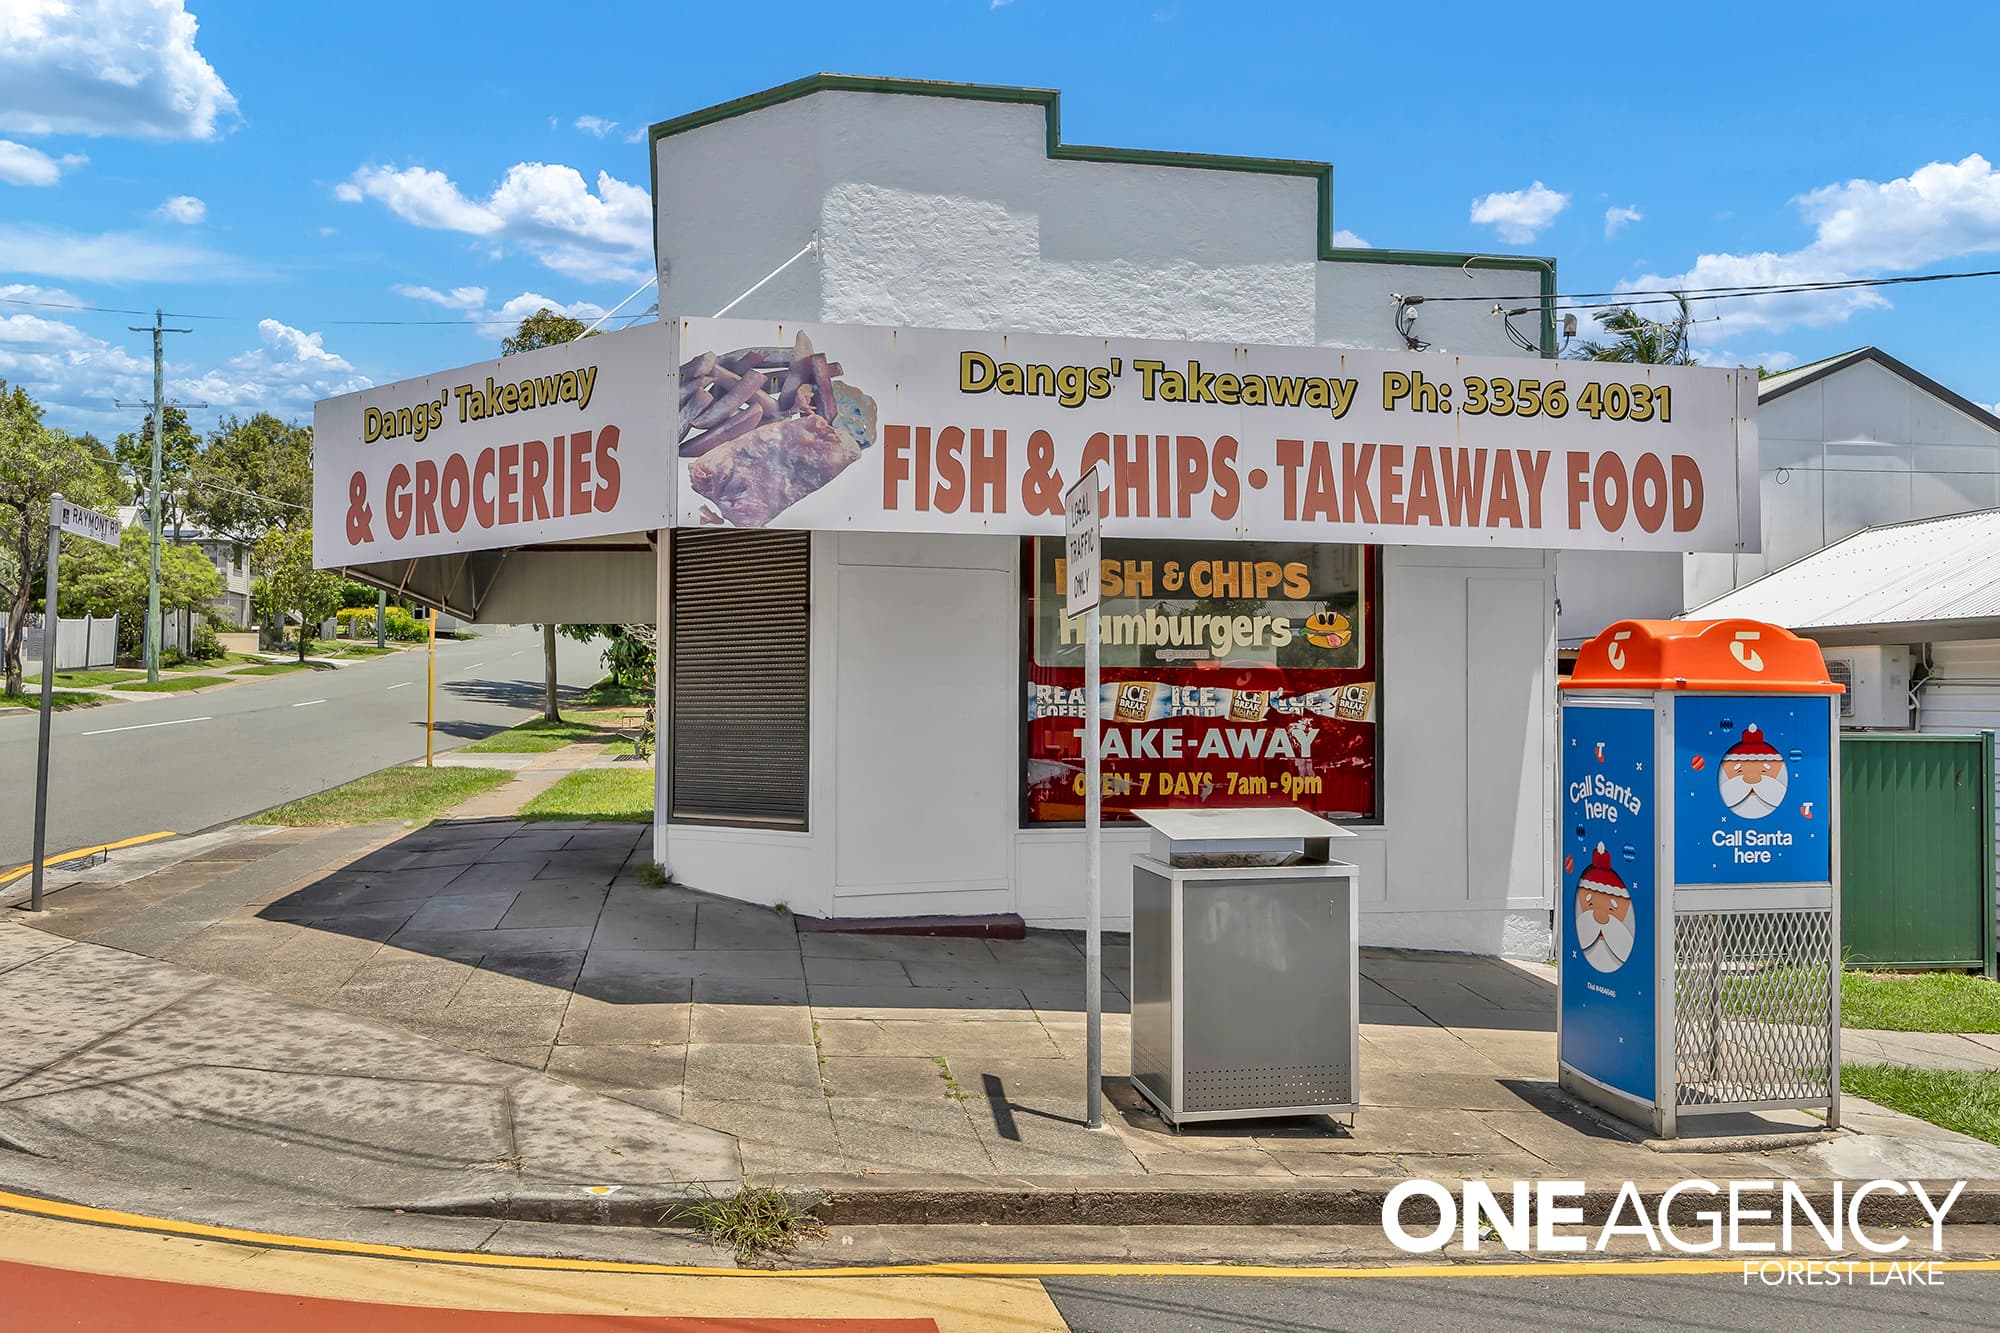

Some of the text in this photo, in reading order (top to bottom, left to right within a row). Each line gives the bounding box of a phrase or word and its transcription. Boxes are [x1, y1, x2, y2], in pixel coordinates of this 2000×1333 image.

[960, 351, 1672, 423] Dangs' Takeaway Ph: 3356 4031
[364, 366, 597, 443] Dangs' Takeaway
[346, 424, 621, 545] & GROCERIES
[883, 424, 1704, 533] FISH & CHIPS TAKEAWAY FOOD
[73, 508, 108, 533] RAYMONT
[110, 521, 119, 536] RD
[1072, 491, 1090, 528] LOCAL
[1070, 527, 1094, 565] TRAFFIC
[1074, 568, 1090, 599] ONLY
[1162, 561, 1184, 591] &
[1189, 560, 1310, 599] CHIPS
[1059, 608, 1293, 658] Hamburgers
[1036, 684, 1086, 705] REA
[1119, 698, 1146, 711] BREAK
[1121, 685, 1150, 703] ICE
[1172, 686, 1215, 706] ICE
[1234, 700, 1260, 712] BREAK
[1340, 699, 1364, 711] BREAK
[1341, 686, 1368, 704] ICE
[1037, 704, 1086, 718] COFFE
[1074, 772, 1130, 796] OEN
[1139, 772, 1151, 796] 7
[1159, 772, 1213, 797] DAYS
[1569, 774, 1641, 817] Call Santa
[1585, 799, 1618, 823] here
[1712, 830, 1792, 846] Call Santa
[1734, 848, 1771, 863] here
